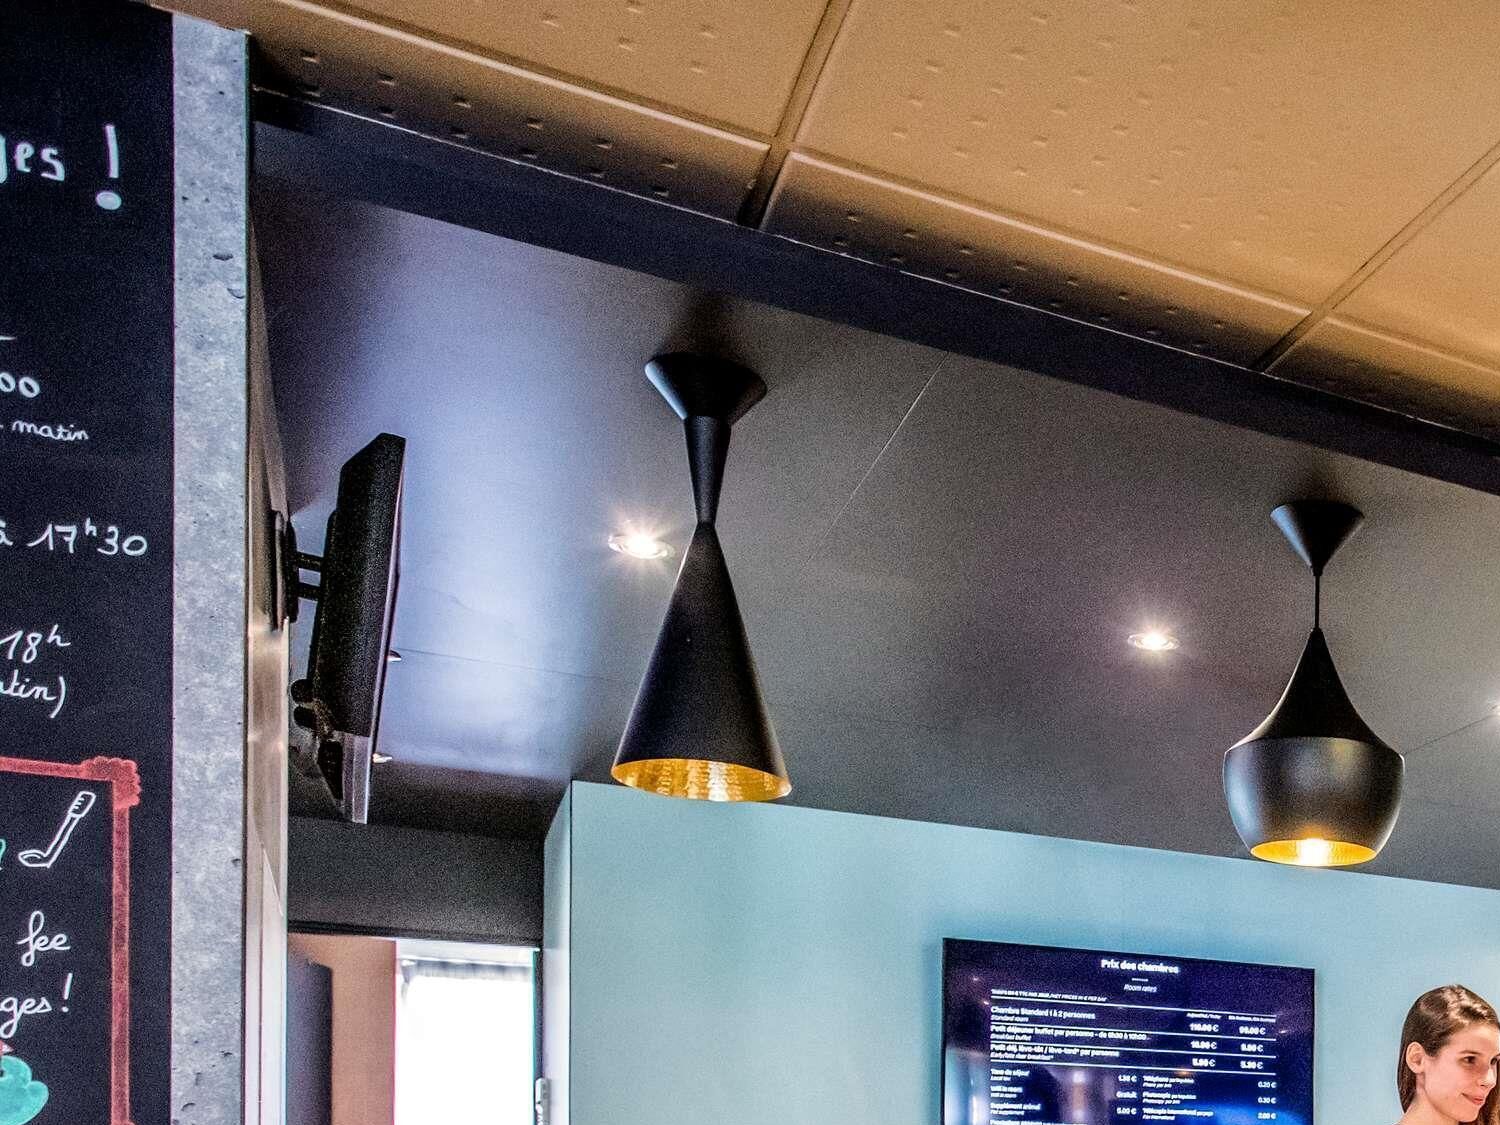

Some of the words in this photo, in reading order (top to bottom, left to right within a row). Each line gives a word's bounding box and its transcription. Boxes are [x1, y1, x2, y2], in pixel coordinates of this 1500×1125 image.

[12, 420, 89, 442] matin
[27, 517, 148, 556] 17h30
[0, 669, 66, 719] tin)
[17, 910, 71, 967] fee
[1101, 959, 1120, 970] Prix
[1120, 961, 1137, 971] des
[1137, 961, 1179, 974] chambres
[1124, 984, 1141, 992] Room
[1142, 985, 1158, 993] rates
[990, 1006, 1019, 1015] Chambre
[1021, 1007, 1049, 1017] Standard
[1058, 1010, 1063, 1018] 2
[1212, 1024, 1219, 1033] €
[1259, 1027, 1266, 1036] €
[1210, 1041, 1217, 1050] €
[1257, 1044, 1264, 1053] €
[1209, 1059, 1216, 1067] €
[1256, 1061, 1263, 1070] €
[1270, 1081, 1277, 1089] €
[1270, 1112, 1276, 1120] €
